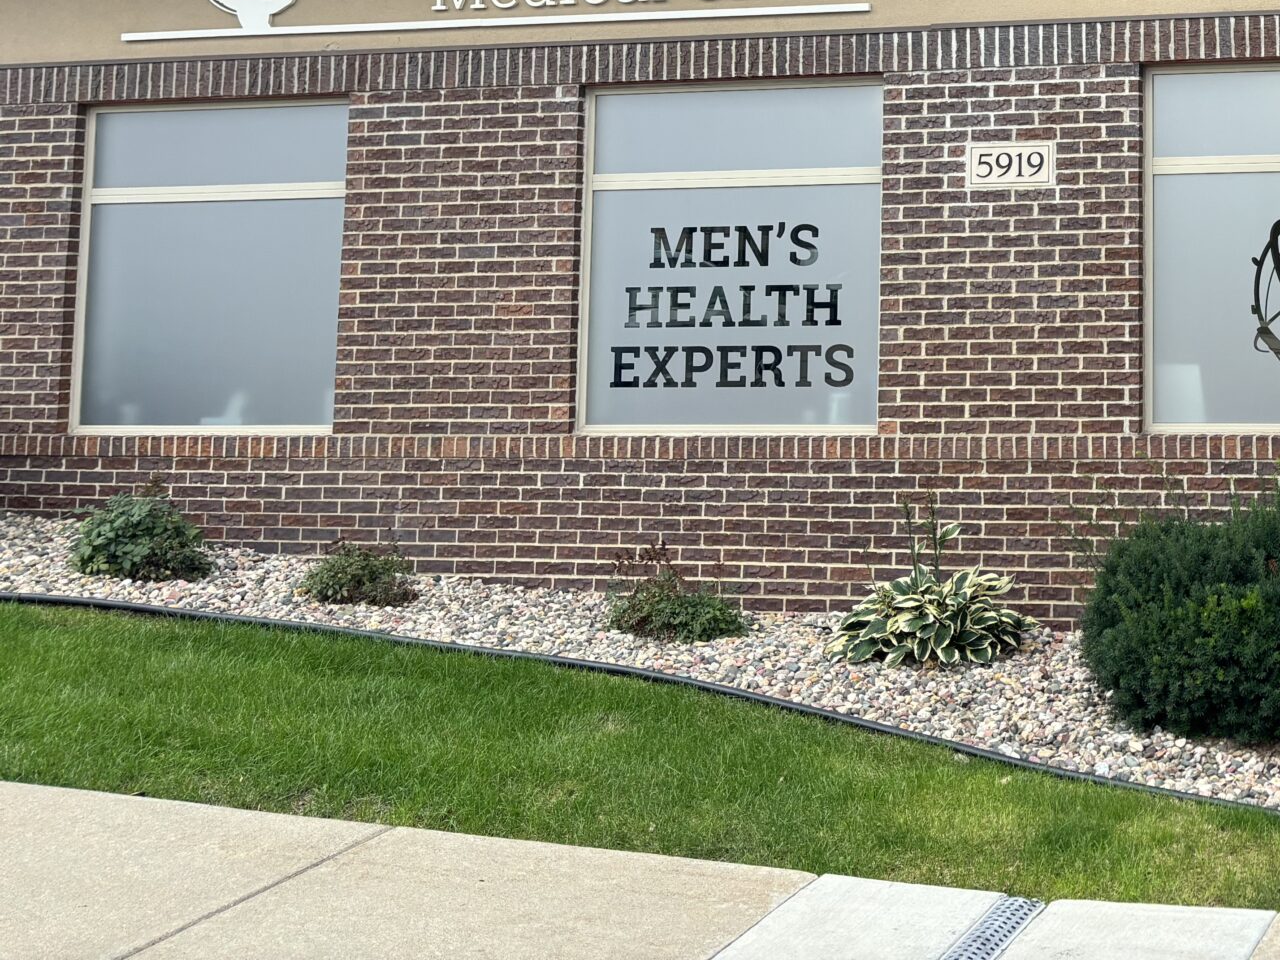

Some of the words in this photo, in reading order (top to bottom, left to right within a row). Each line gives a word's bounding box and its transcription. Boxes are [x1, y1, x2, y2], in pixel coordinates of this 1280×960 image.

[975, 151, 1045, 179] 5919
[648, 221, 820, 269] MEN'S
[624, 283, 843, 328] HEALTH
[609, 343, 855, 388] EXPERTS
